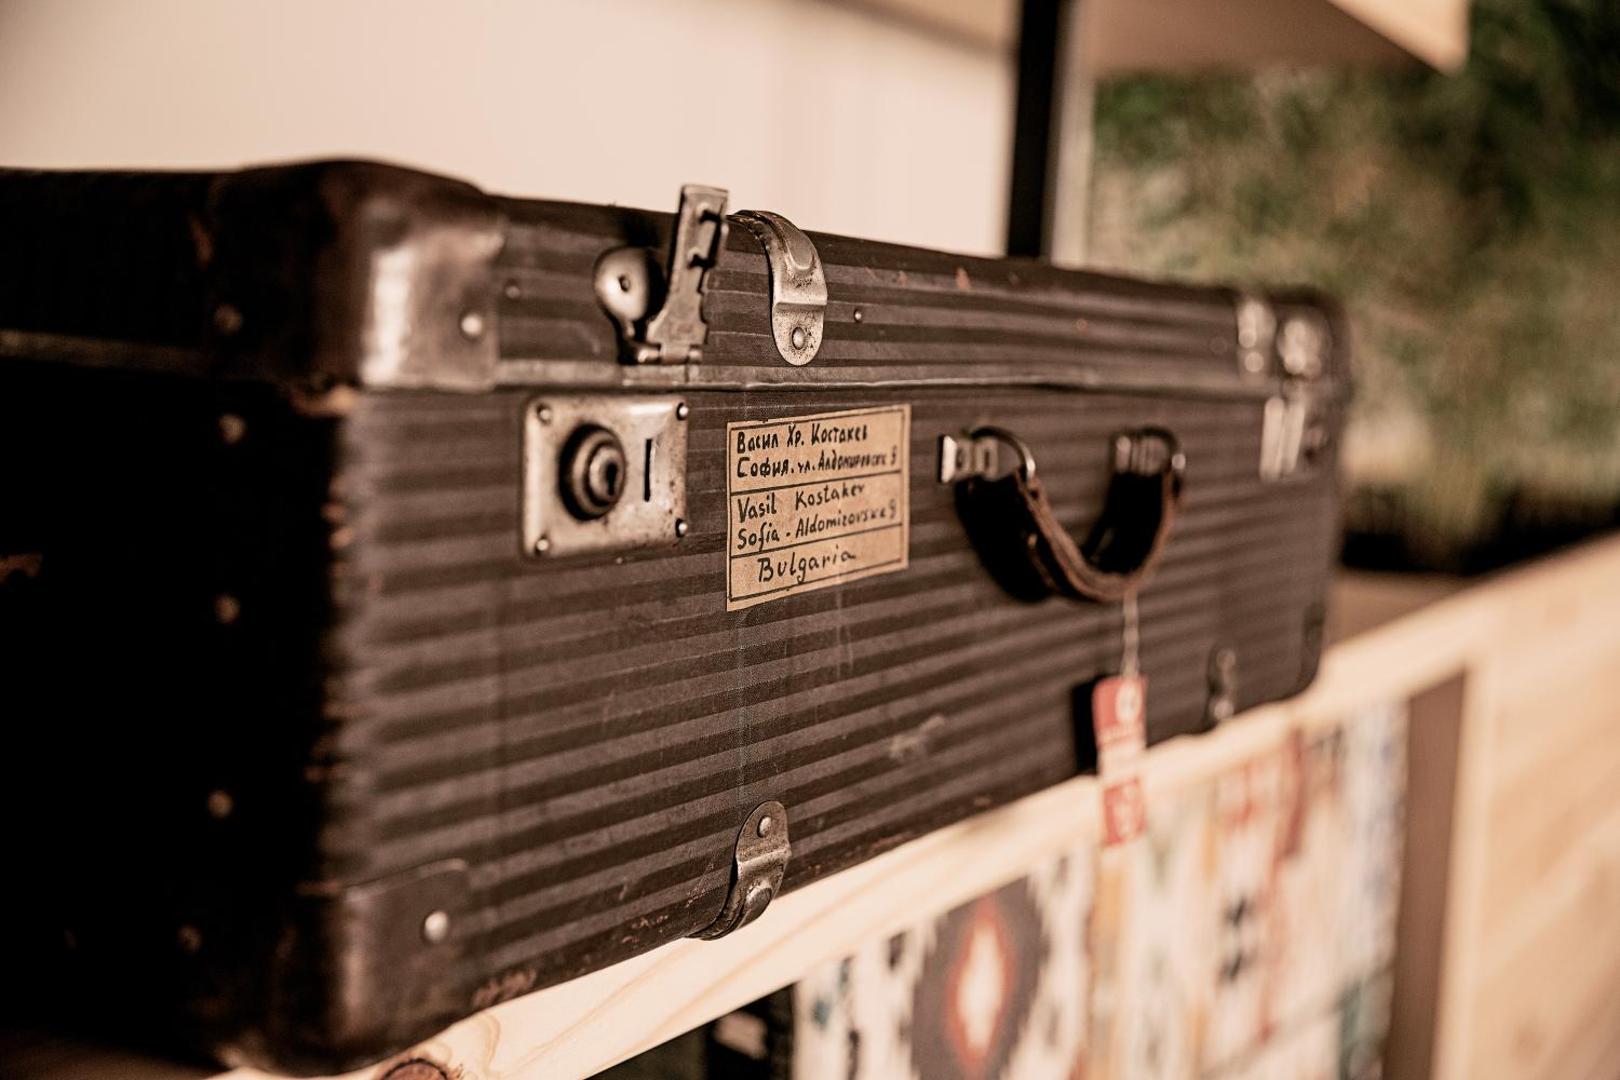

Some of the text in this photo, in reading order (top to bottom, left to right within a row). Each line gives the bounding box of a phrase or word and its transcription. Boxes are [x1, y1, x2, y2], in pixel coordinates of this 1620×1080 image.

[737, 432, 778, 454] Васил
[737, 493, 777, 523] Vasil
[737, 523, 780, 552] Sofia
[757, 544, 857, 584] Bulgaria
